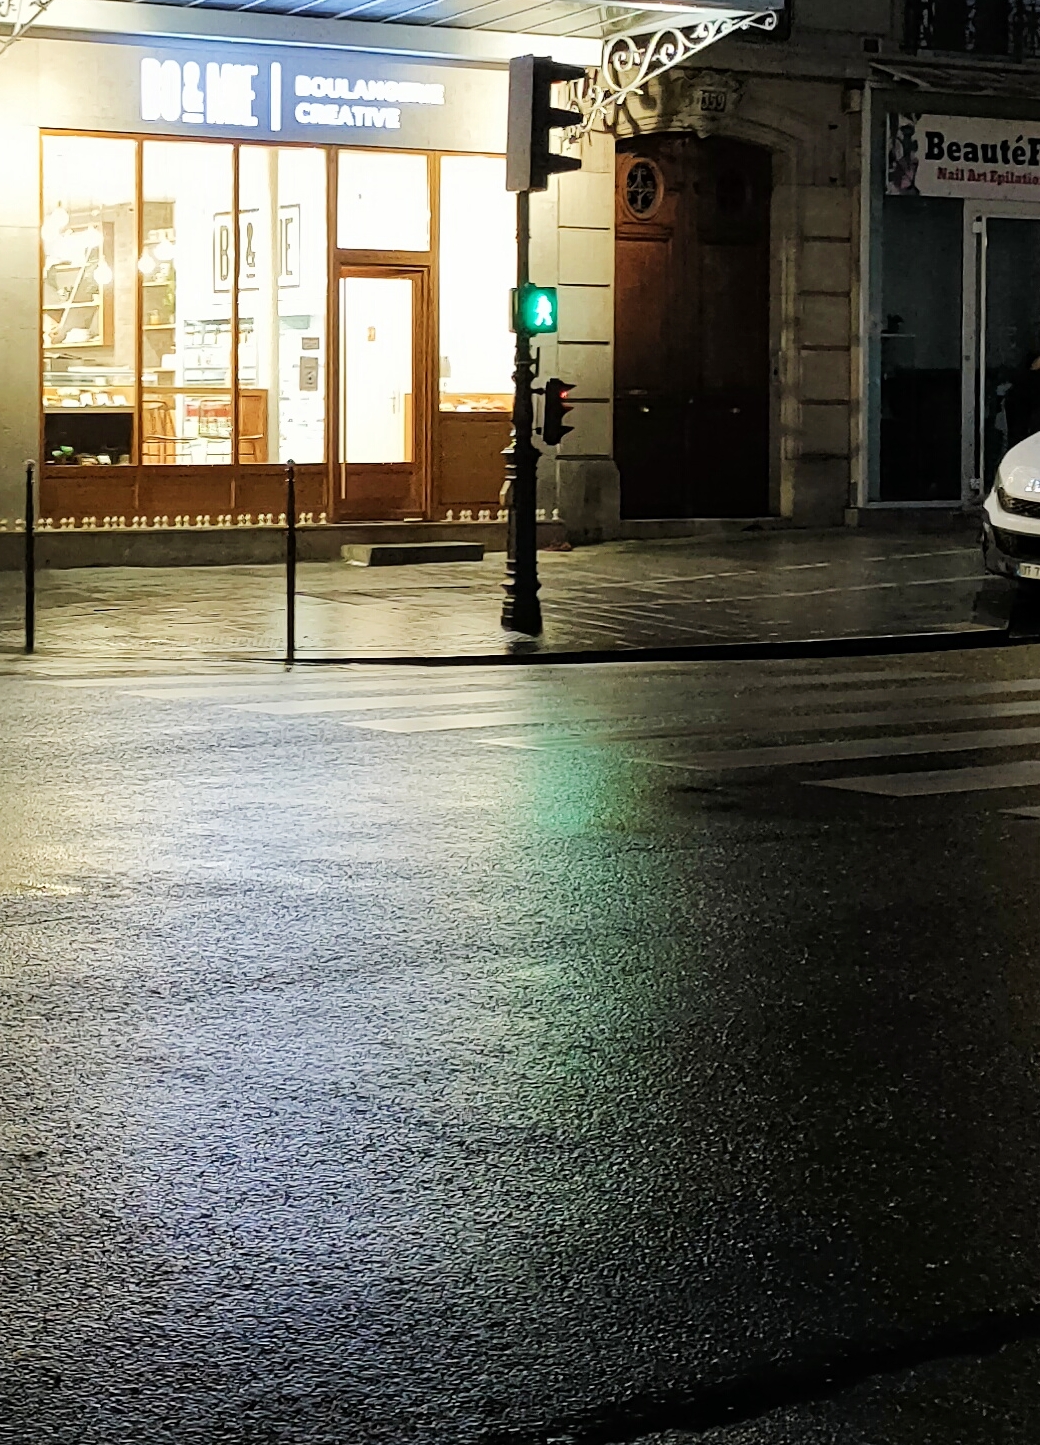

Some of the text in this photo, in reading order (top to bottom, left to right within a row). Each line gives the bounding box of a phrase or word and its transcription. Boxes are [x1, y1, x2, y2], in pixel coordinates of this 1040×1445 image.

[937, 166, 1040, 186] Nail Art Epilatio
